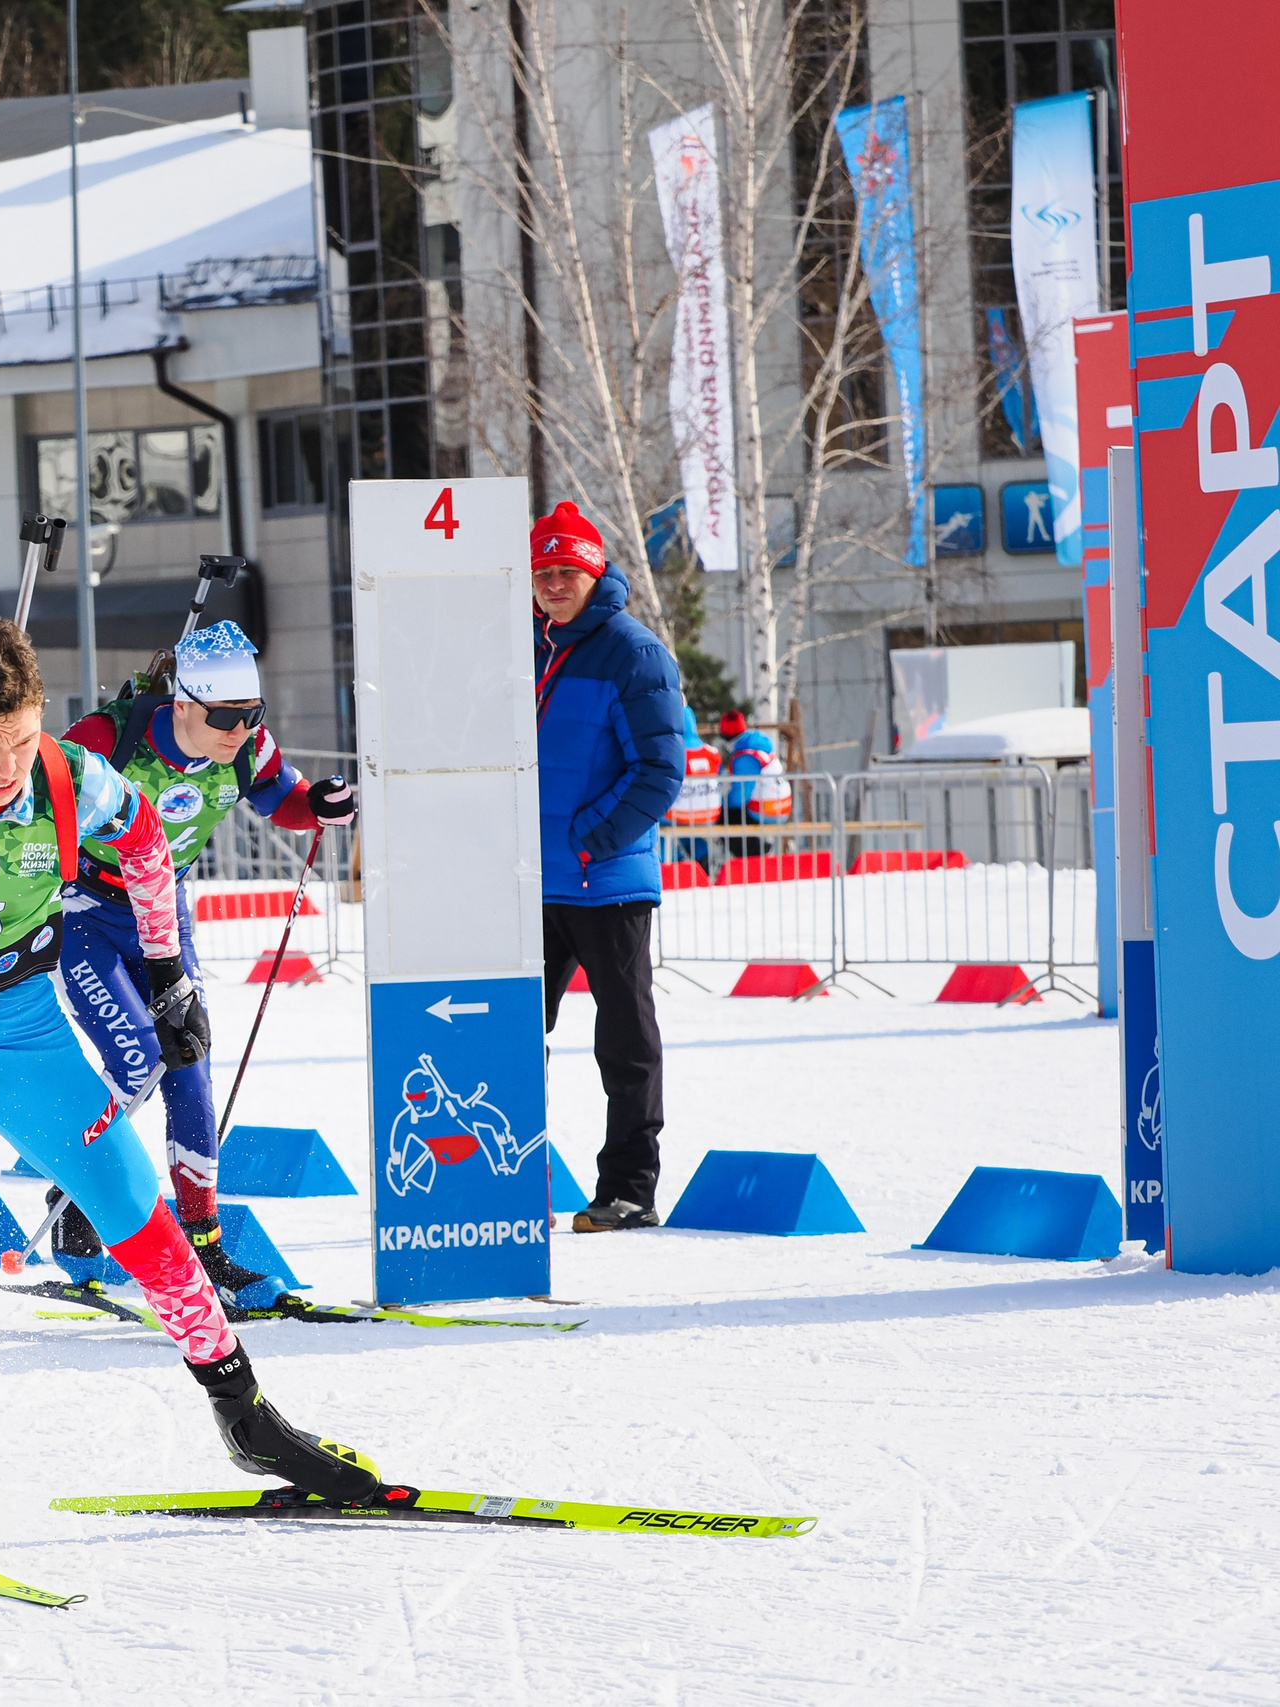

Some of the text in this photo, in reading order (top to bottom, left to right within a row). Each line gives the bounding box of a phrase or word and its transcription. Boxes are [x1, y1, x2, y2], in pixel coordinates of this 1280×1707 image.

[424, 487, 460, 540] 4
[1188, 213, 1280, 960] СТАРТ
[20, 860, 55, 869] ЖИЗНИ
[21, 851, 57, 861] НОРМА
[69, 959, 151, 1093] МОРДОВИЯ
[1131, 1180, 1165, 1204] КР
[379, 1217, 545, 1251] КРАСНОЯРСК
[216, 1357, 242, 1377] 193
[341, 1508, 389, 1516] FISCHER
[616, 1511, 760, 1534] FISCHER
